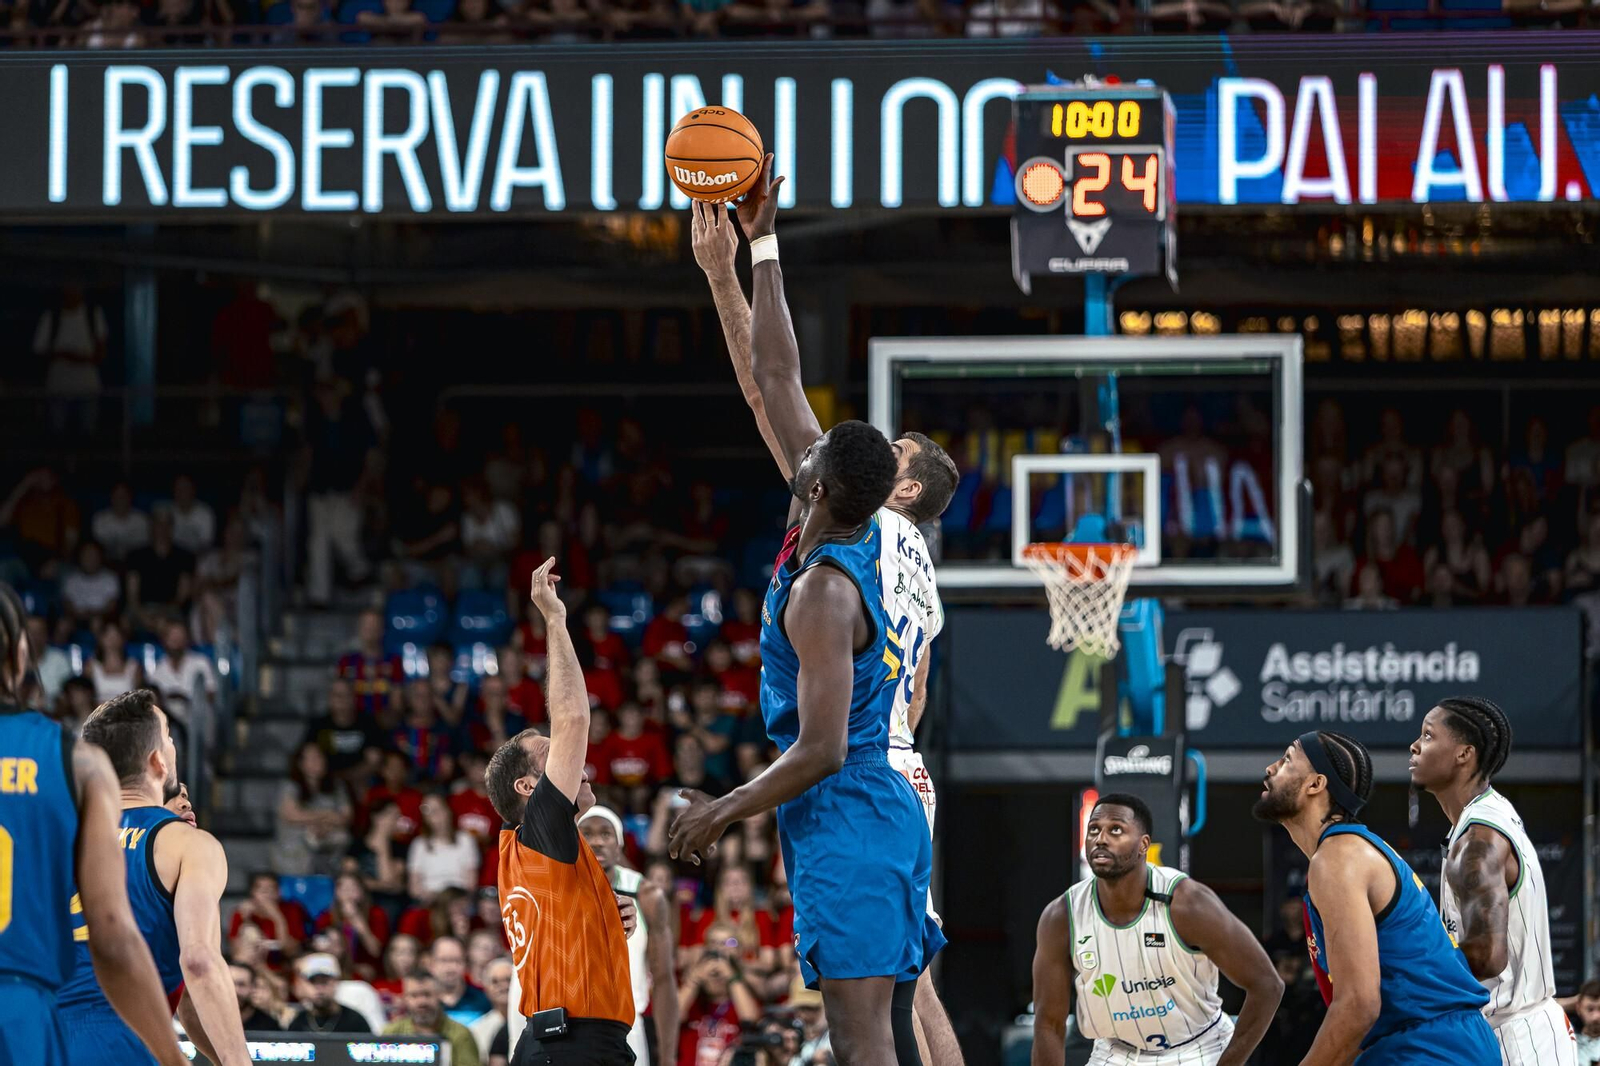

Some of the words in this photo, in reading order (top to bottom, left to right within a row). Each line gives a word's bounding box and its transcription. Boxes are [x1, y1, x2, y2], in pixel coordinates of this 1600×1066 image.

[699, 108, 725, 116] acb
[1052, 101, 1140, 138] 10:00
[49, 65, 68, 202] I
[103, 66, 565, 212] RESERVA
[674, 166, 738, 186] Wilson
[1072, 153, 1158, 216] 24
[1049, 257, 1129, 272] CUPRA
[1261, 643, 1480, 682] Assistència
[1261, 682, 1415, 722] Sanitària
[0, 757, 38, 793] ER
[117, 827, 146, 849] KY
